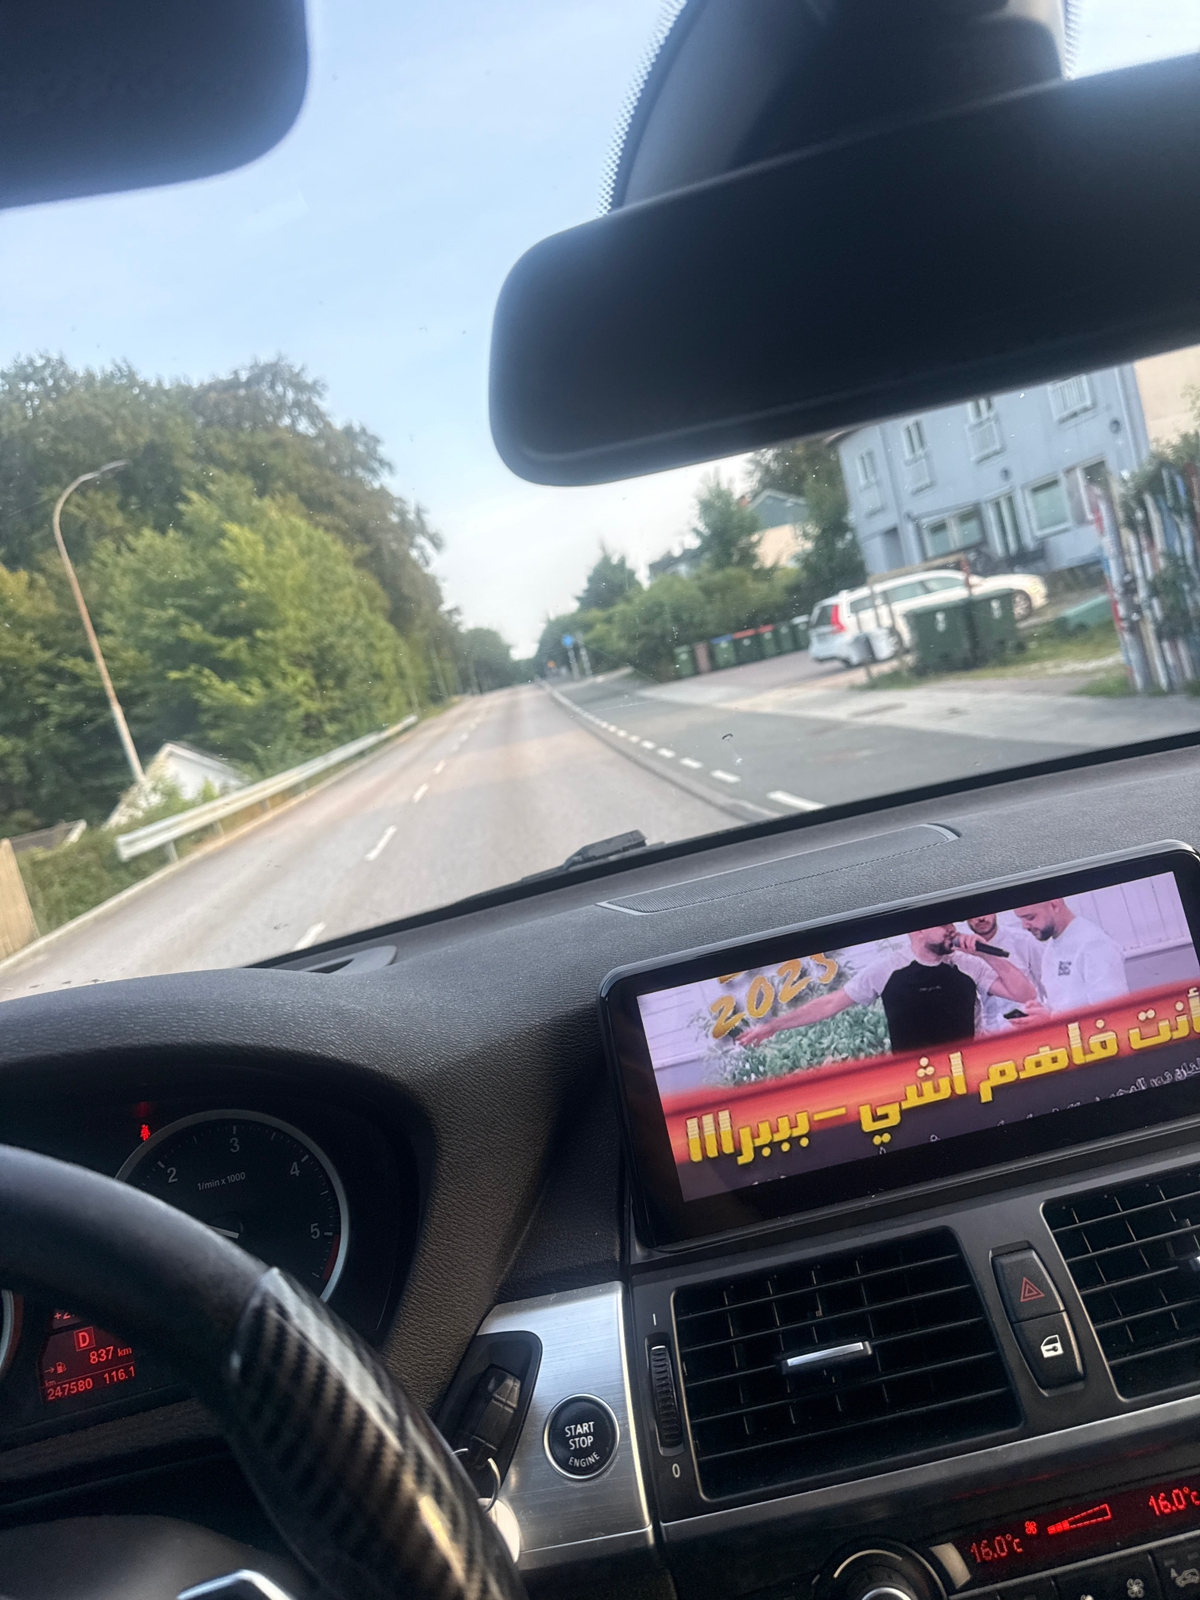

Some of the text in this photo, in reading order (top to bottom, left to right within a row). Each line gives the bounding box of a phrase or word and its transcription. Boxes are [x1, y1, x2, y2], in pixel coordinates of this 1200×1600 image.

[978, 1019, 1118, 1103] فاهم
[230, 1137, 240, 1153] 3
[167, 1167, 178, 1183] 2
[290, 1161, 301, 1177] 4
[310, 1223, 321, 1239] 5
[78, 1332, 90, 1348] D
[89, 1346, 132, 1364] 837 km
[47, 1366, 135, 1400] 247580 116.1
[564, 1421, 595, 1438] START
[568, 1435, 594, 1450] STOP
[568, 1451, 600, 1468] ENGINE
